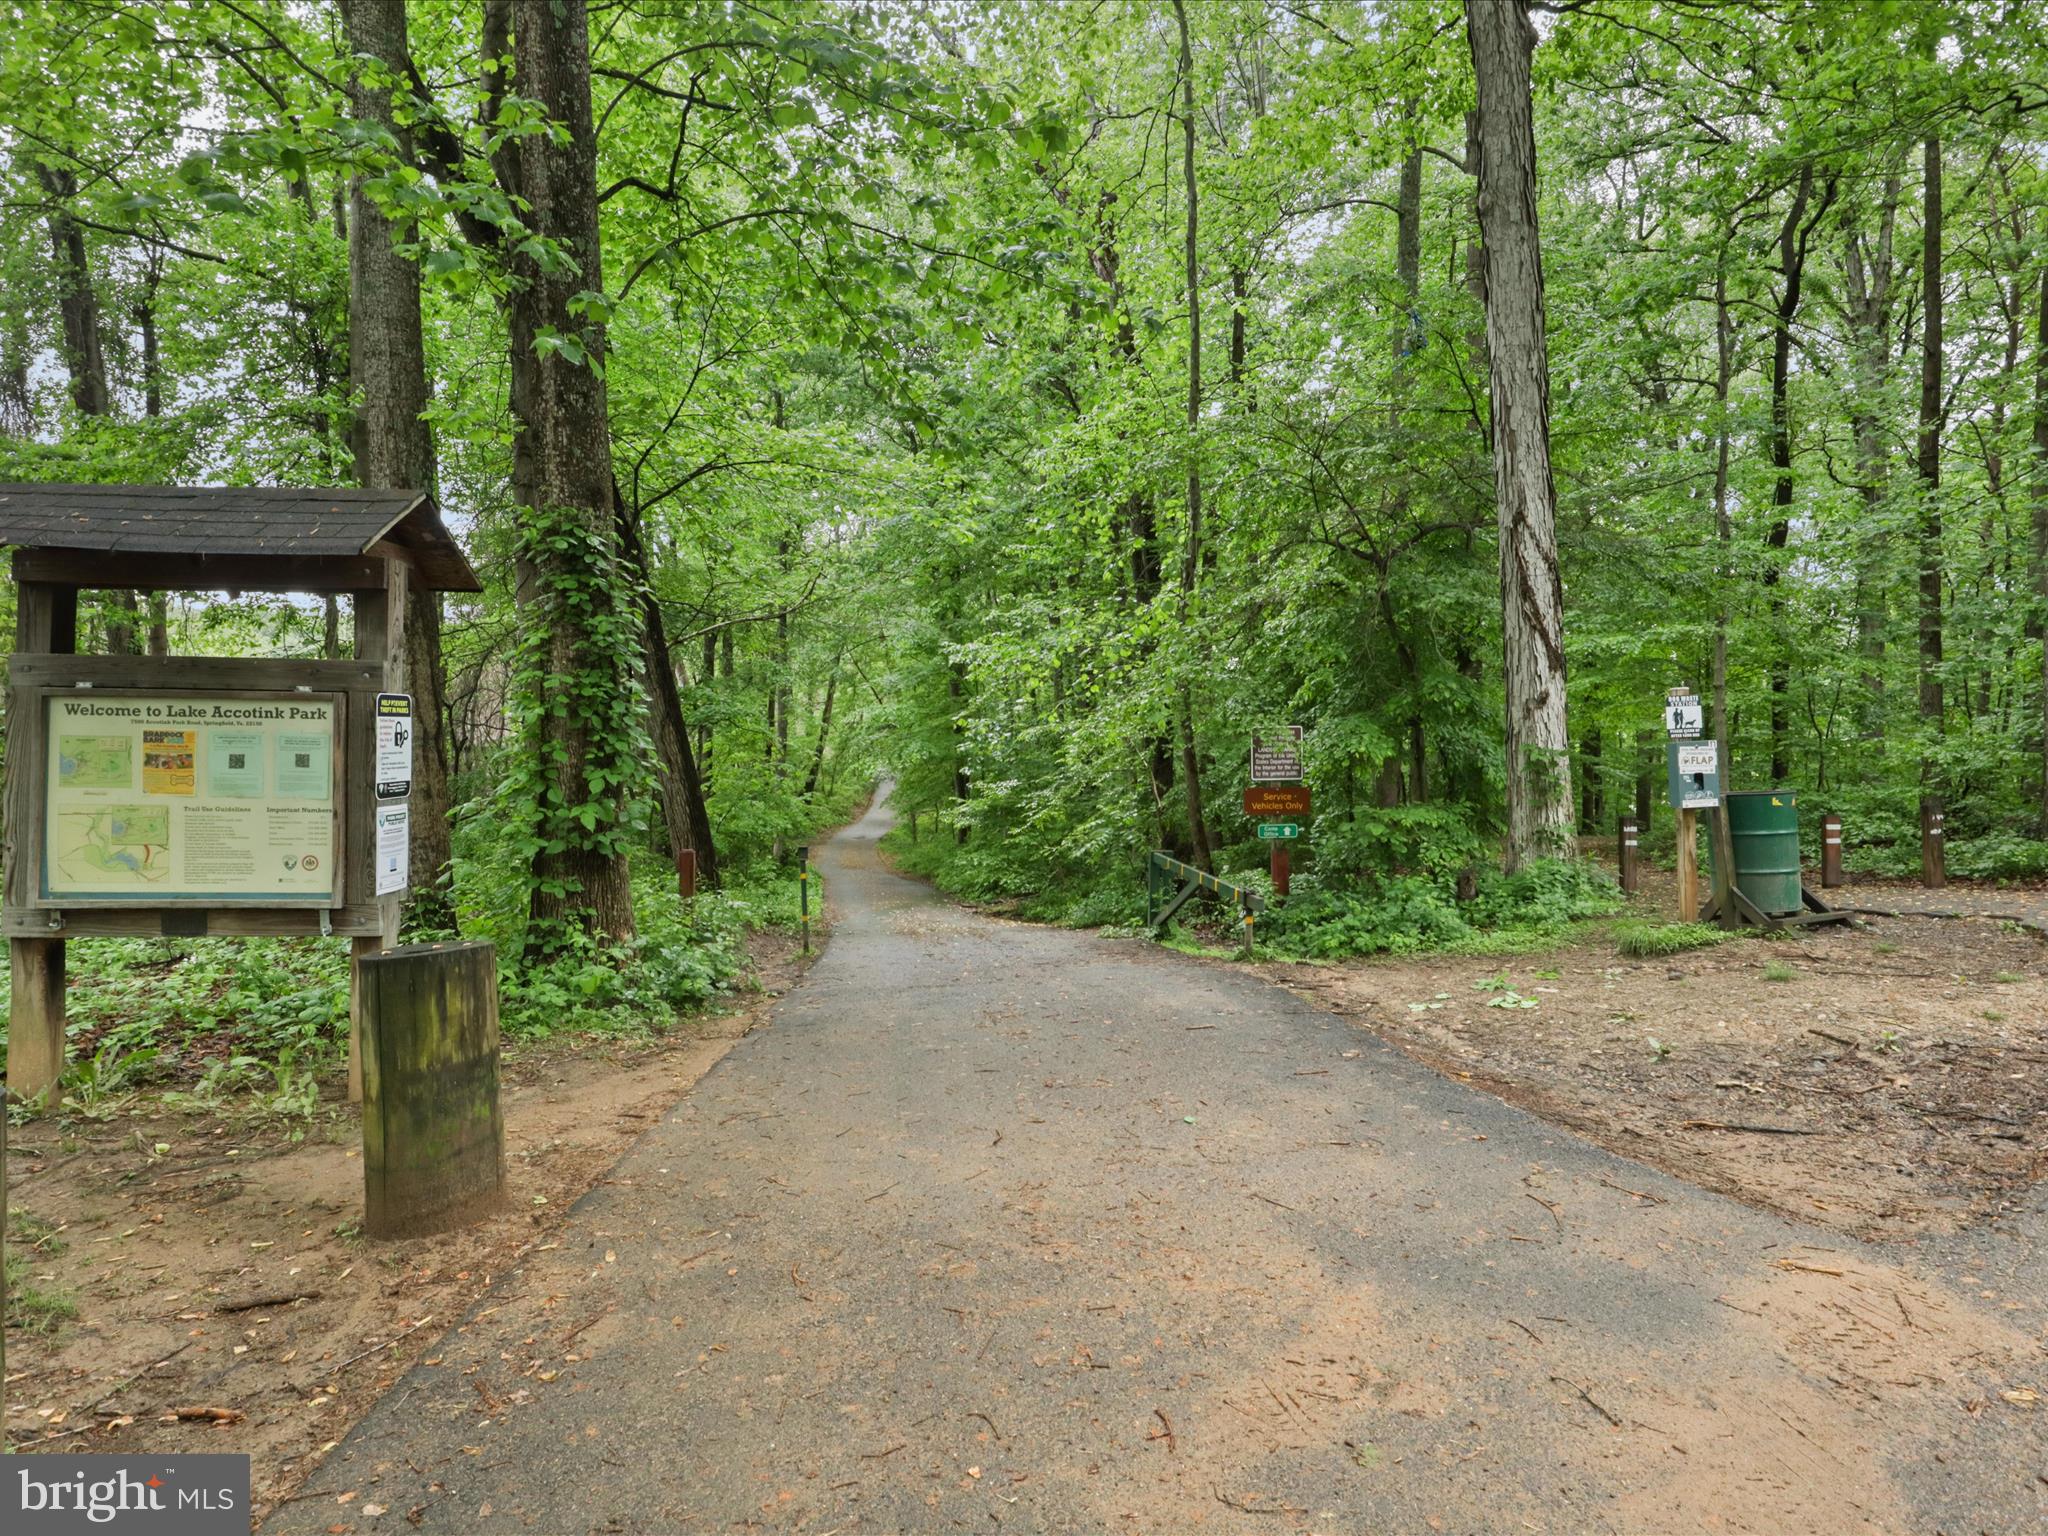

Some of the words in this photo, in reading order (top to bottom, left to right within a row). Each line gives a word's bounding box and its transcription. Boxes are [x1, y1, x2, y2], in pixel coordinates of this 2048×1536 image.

[64, 703, 142, 717] Welcome
[147, 705, 162, 718] to
[166, 705, 207, 718] Lake
[211, 705, 286, 720] Accotink
[289, 707, 328, 720] Park
[1691, 756, 1714, 765] FLAP
[1263, 792, 1292, 801] Service
[1251, 802, 1283, 810] Vehicles
[1285, 802, 1304, 811] Only
